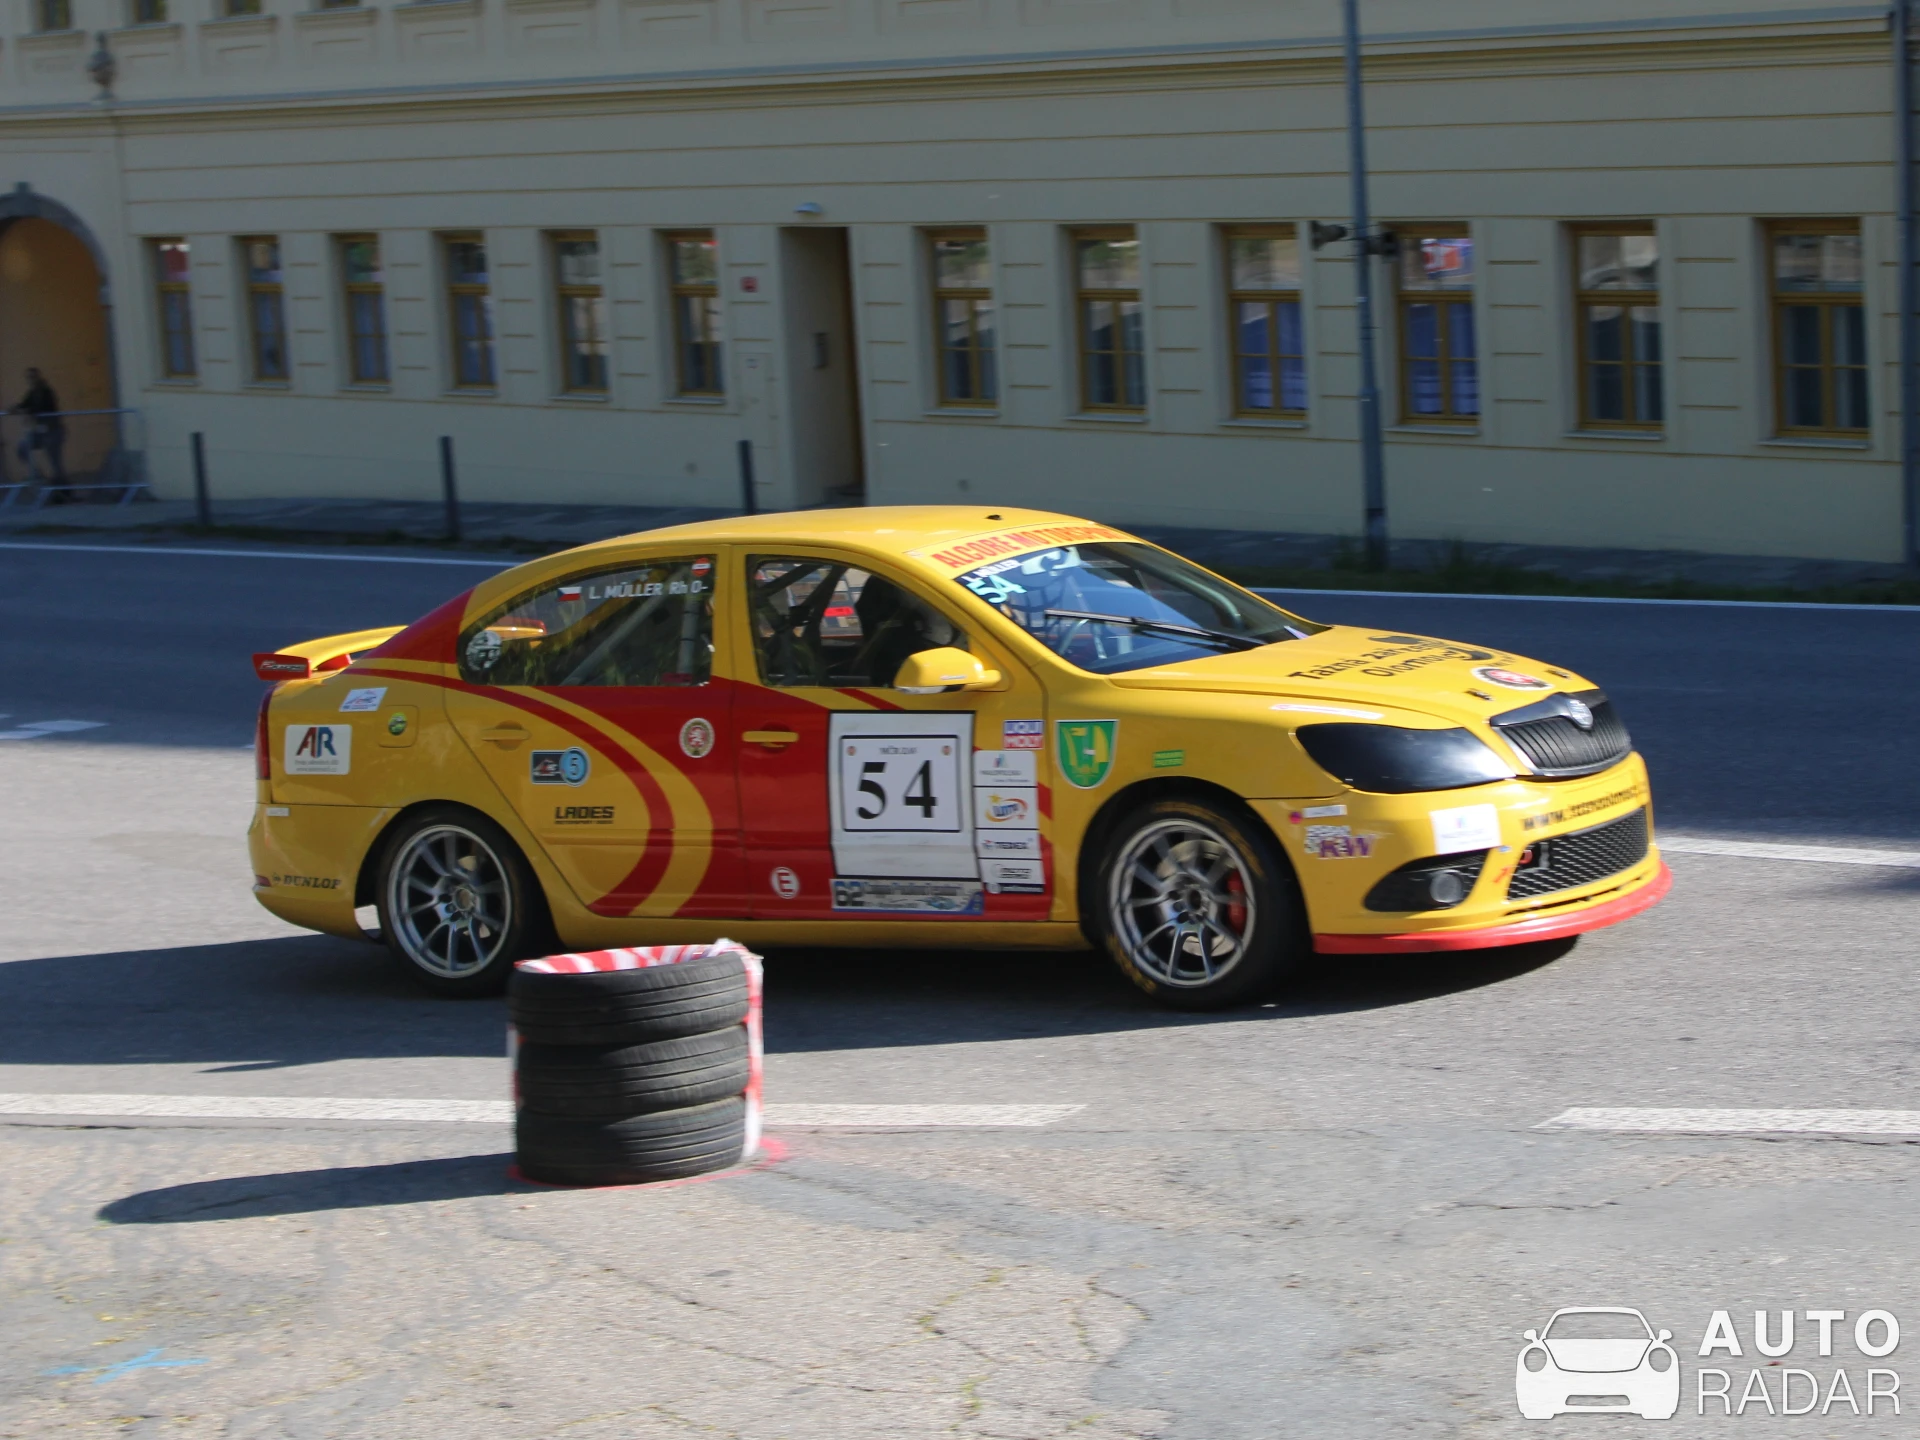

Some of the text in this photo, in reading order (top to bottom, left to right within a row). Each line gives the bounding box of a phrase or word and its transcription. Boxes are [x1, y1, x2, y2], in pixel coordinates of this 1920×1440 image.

[931, 536, 1016, 568] ALCORE
[604, 582, 663, 599] MÜLLER
[966, 574, 1027, 604] 54
[856, 760, 938, 820] 54
[283, 875, 341, 889] DUNLOP
[776, 871, 793, 894] E
